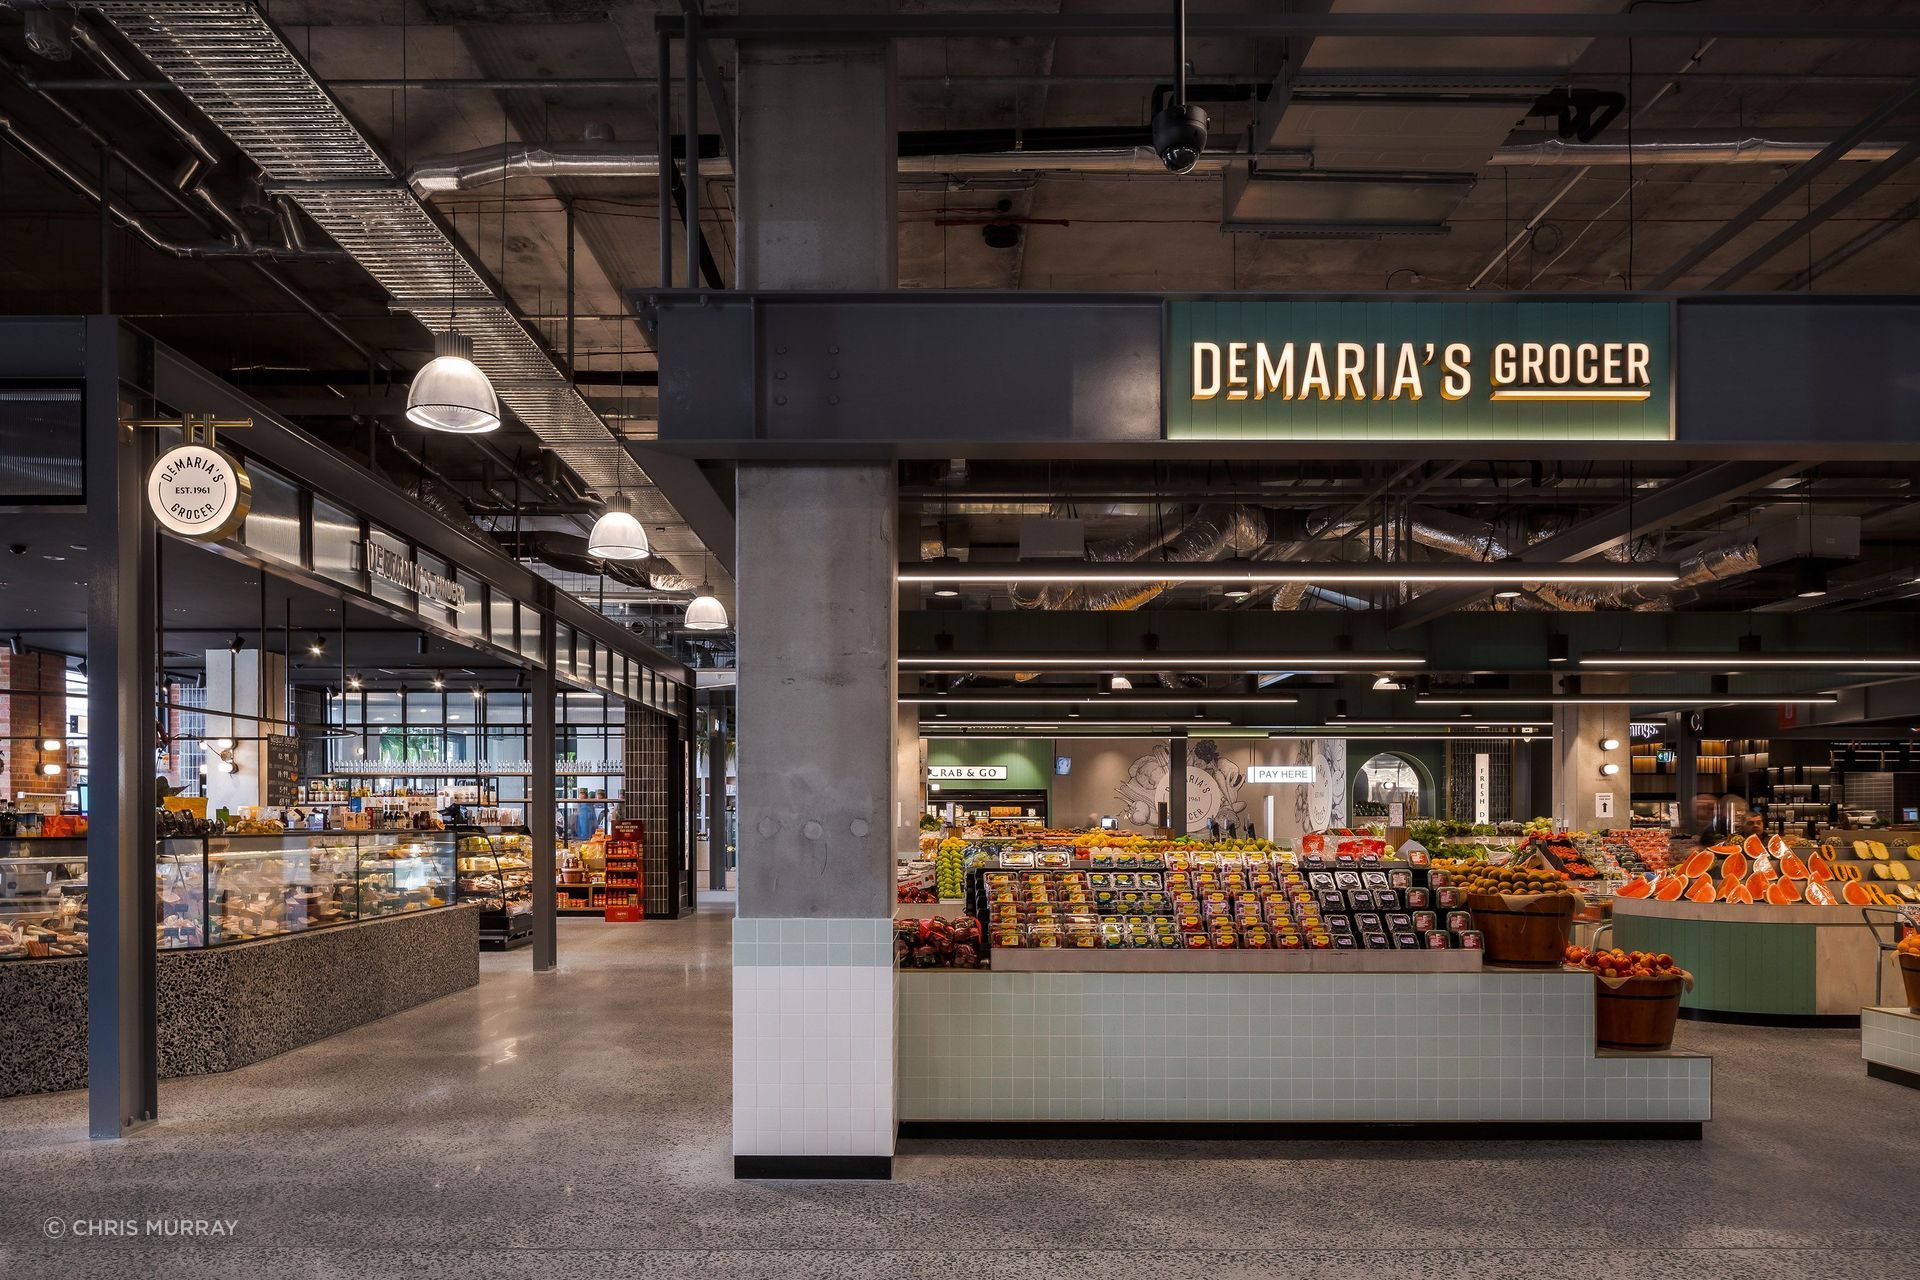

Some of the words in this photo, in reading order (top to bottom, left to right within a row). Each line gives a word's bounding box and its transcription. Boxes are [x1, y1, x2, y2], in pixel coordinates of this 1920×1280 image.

[1191, 341, 1472, 400] DEMARIA'S
[1490, 342, 1651, 388] GROCER
[161, 456, 224, 483] DEMARIA'S
[171, 503, 215, 520] GROCER
[966, 768, 975, 777] &
[979, 768, 997, 777] GO
[1259, 770, 1278, 779] PAY
[1281, 770, 1308, 779] HERE
